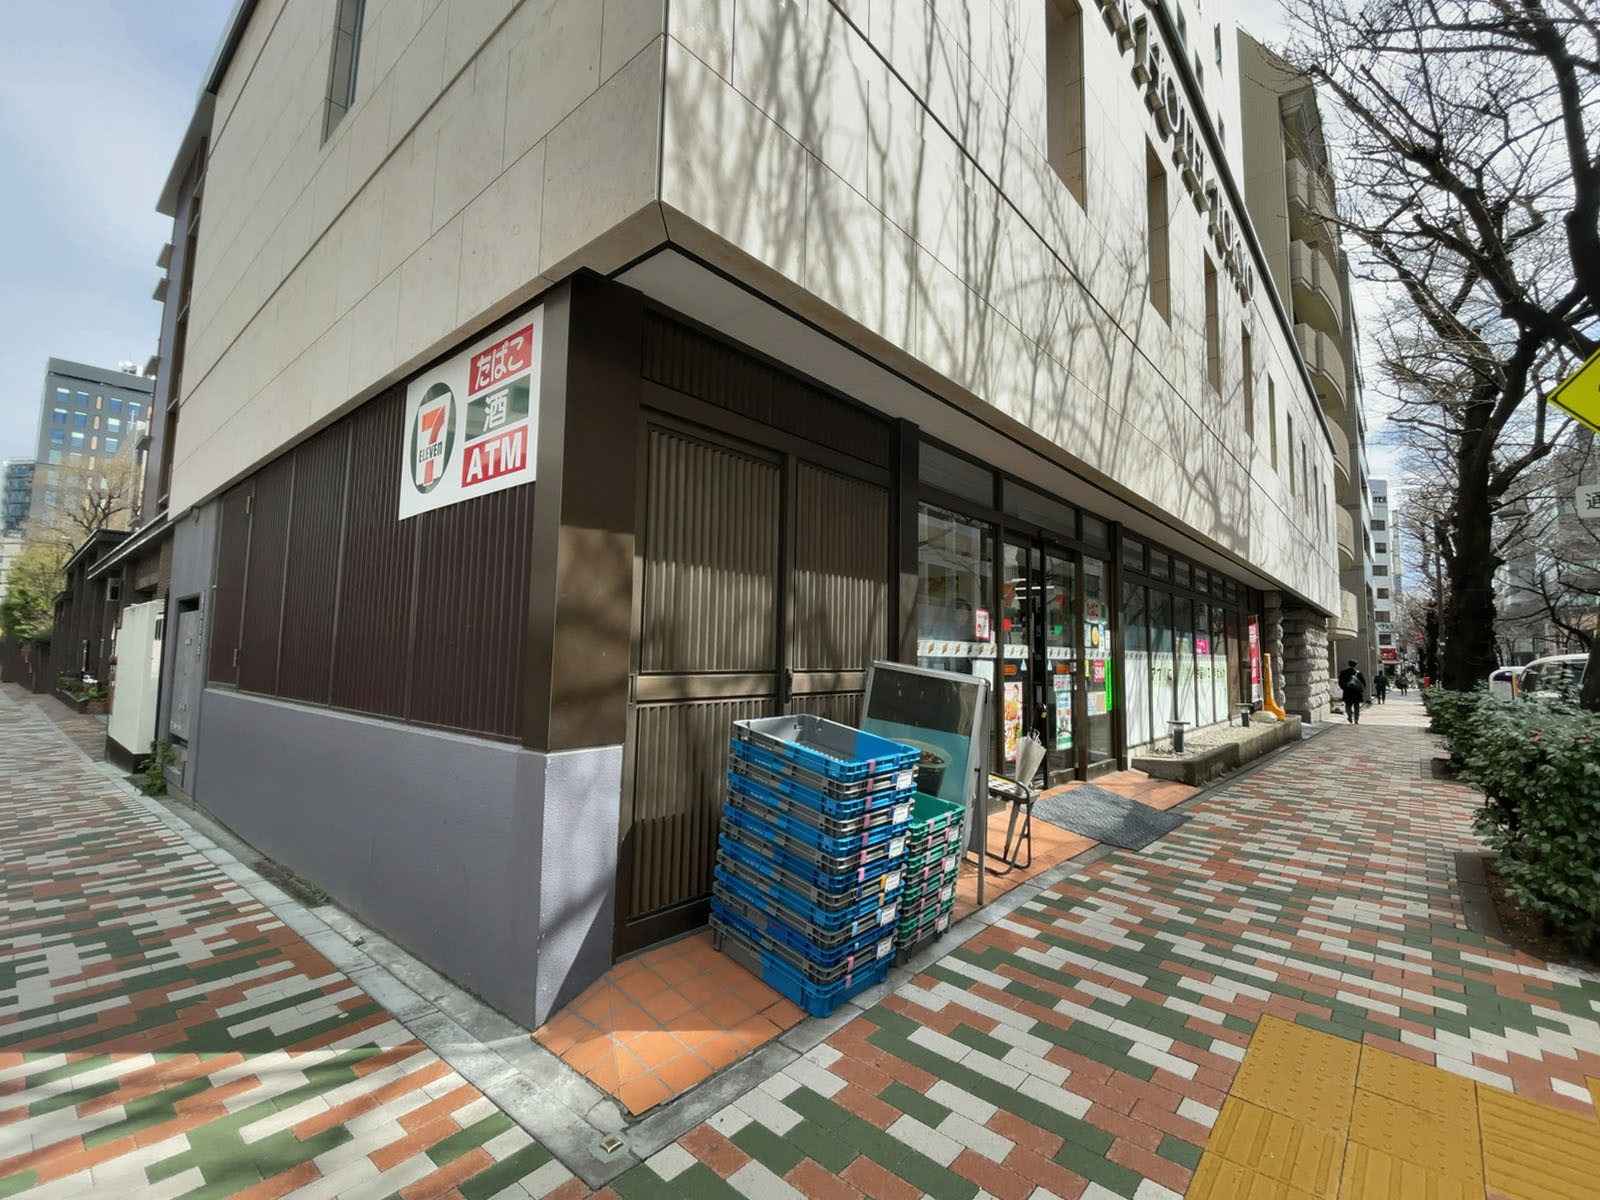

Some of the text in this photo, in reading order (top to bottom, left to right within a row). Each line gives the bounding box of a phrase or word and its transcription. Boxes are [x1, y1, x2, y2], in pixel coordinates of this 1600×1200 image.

[1134, 13, 1209, 214] HOTEL
[475, 336, 525, 391] たばこ
[483, 388, 509, 433] 酒
[466, 431, 522, 483] ATM
